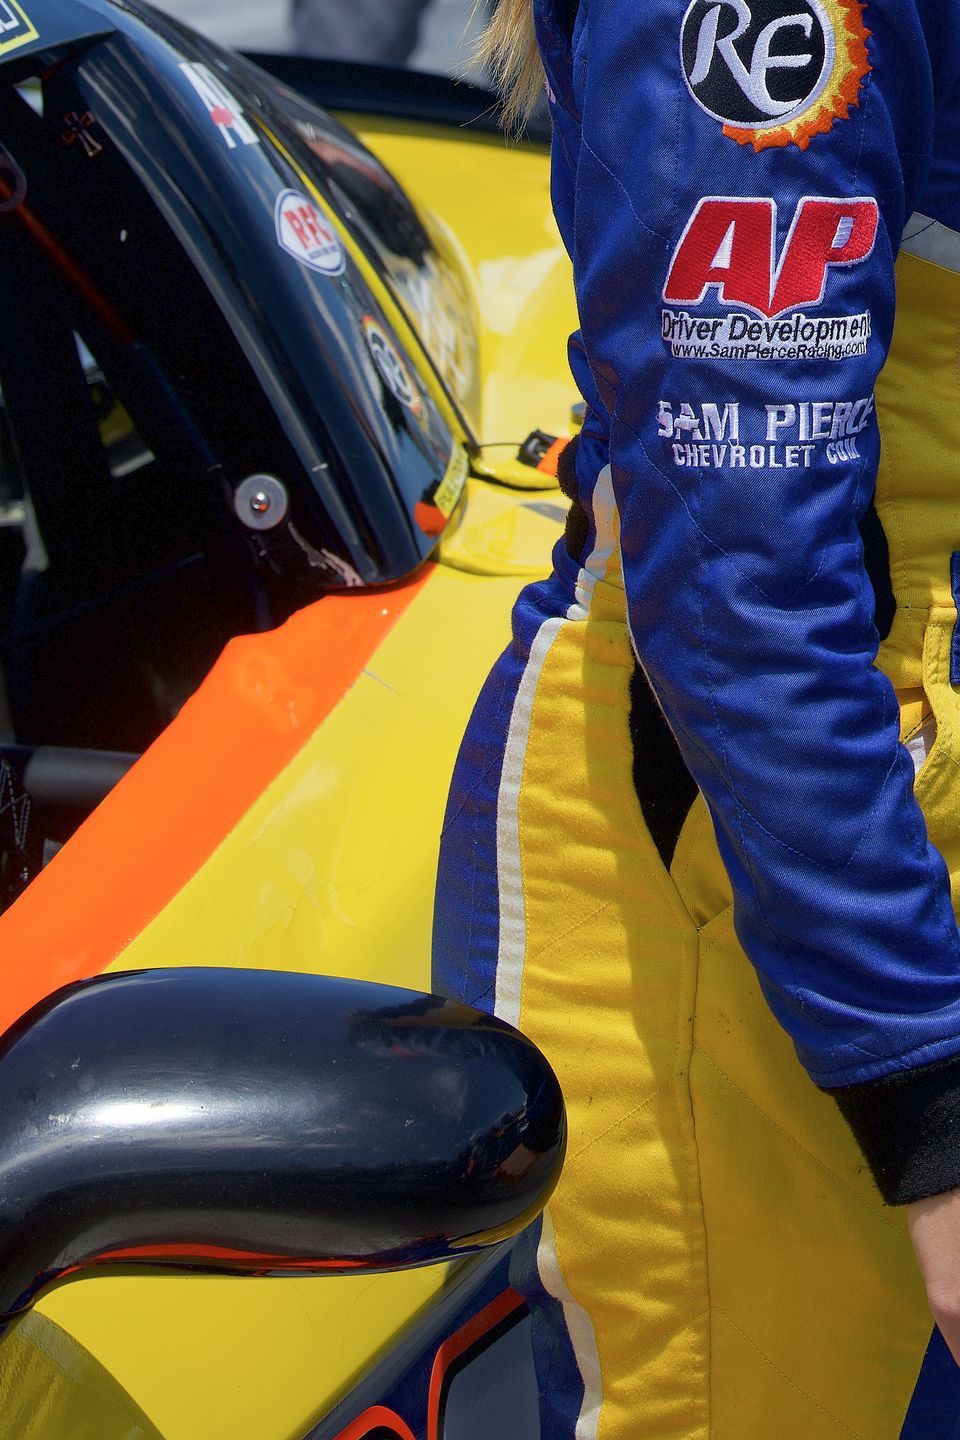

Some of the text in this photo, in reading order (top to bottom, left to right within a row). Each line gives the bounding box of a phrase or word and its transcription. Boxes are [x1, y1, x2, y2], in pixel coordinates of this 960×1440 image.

[662, 195, 880, 321] AP
[663, 310, 723, 342] Driver
[658, 400, 740, 441] SAM
[672, 443, 816, 469] CHEVROLET
